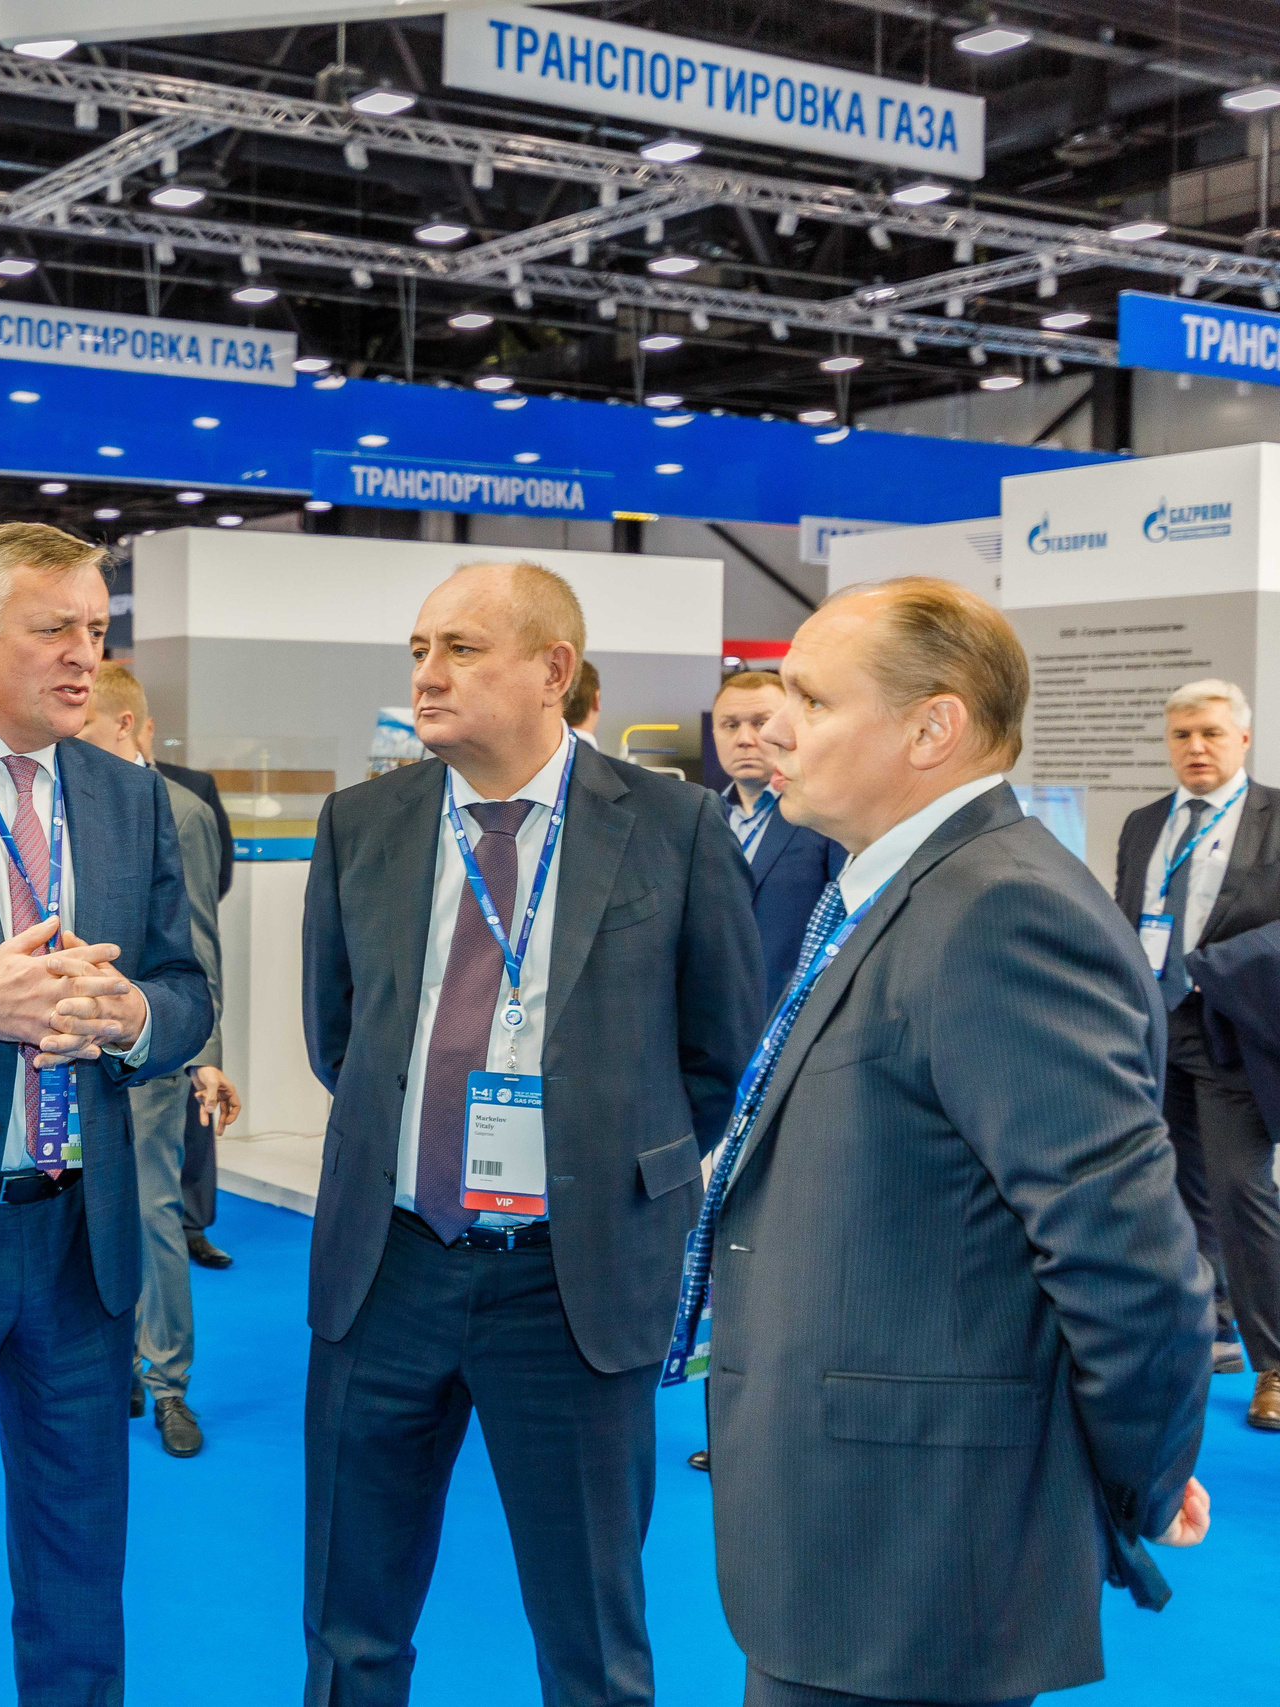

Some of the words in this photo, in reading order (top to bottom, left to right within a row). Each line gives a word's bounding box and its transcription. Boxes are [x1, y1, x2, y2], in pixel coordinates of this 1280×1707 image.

[489, 20, 866, 136] ТРАНСПОРТИРОВКА
[878, 98, 959, 153] ГАЗА
[209, 337, 275, 372] ГАЗА
[1181, 313, 1280, 371] ТРАНС
[350, 464, 585, 511] ТРАНСПОРТИРОВКА
[1170, 503, 1232, 525] GAZPROM
[475, 1114, 507, 1123] Markelov
[475, 1122, 495, 1131] Vitaly
[495, 1197, 514, 1207] VIP
